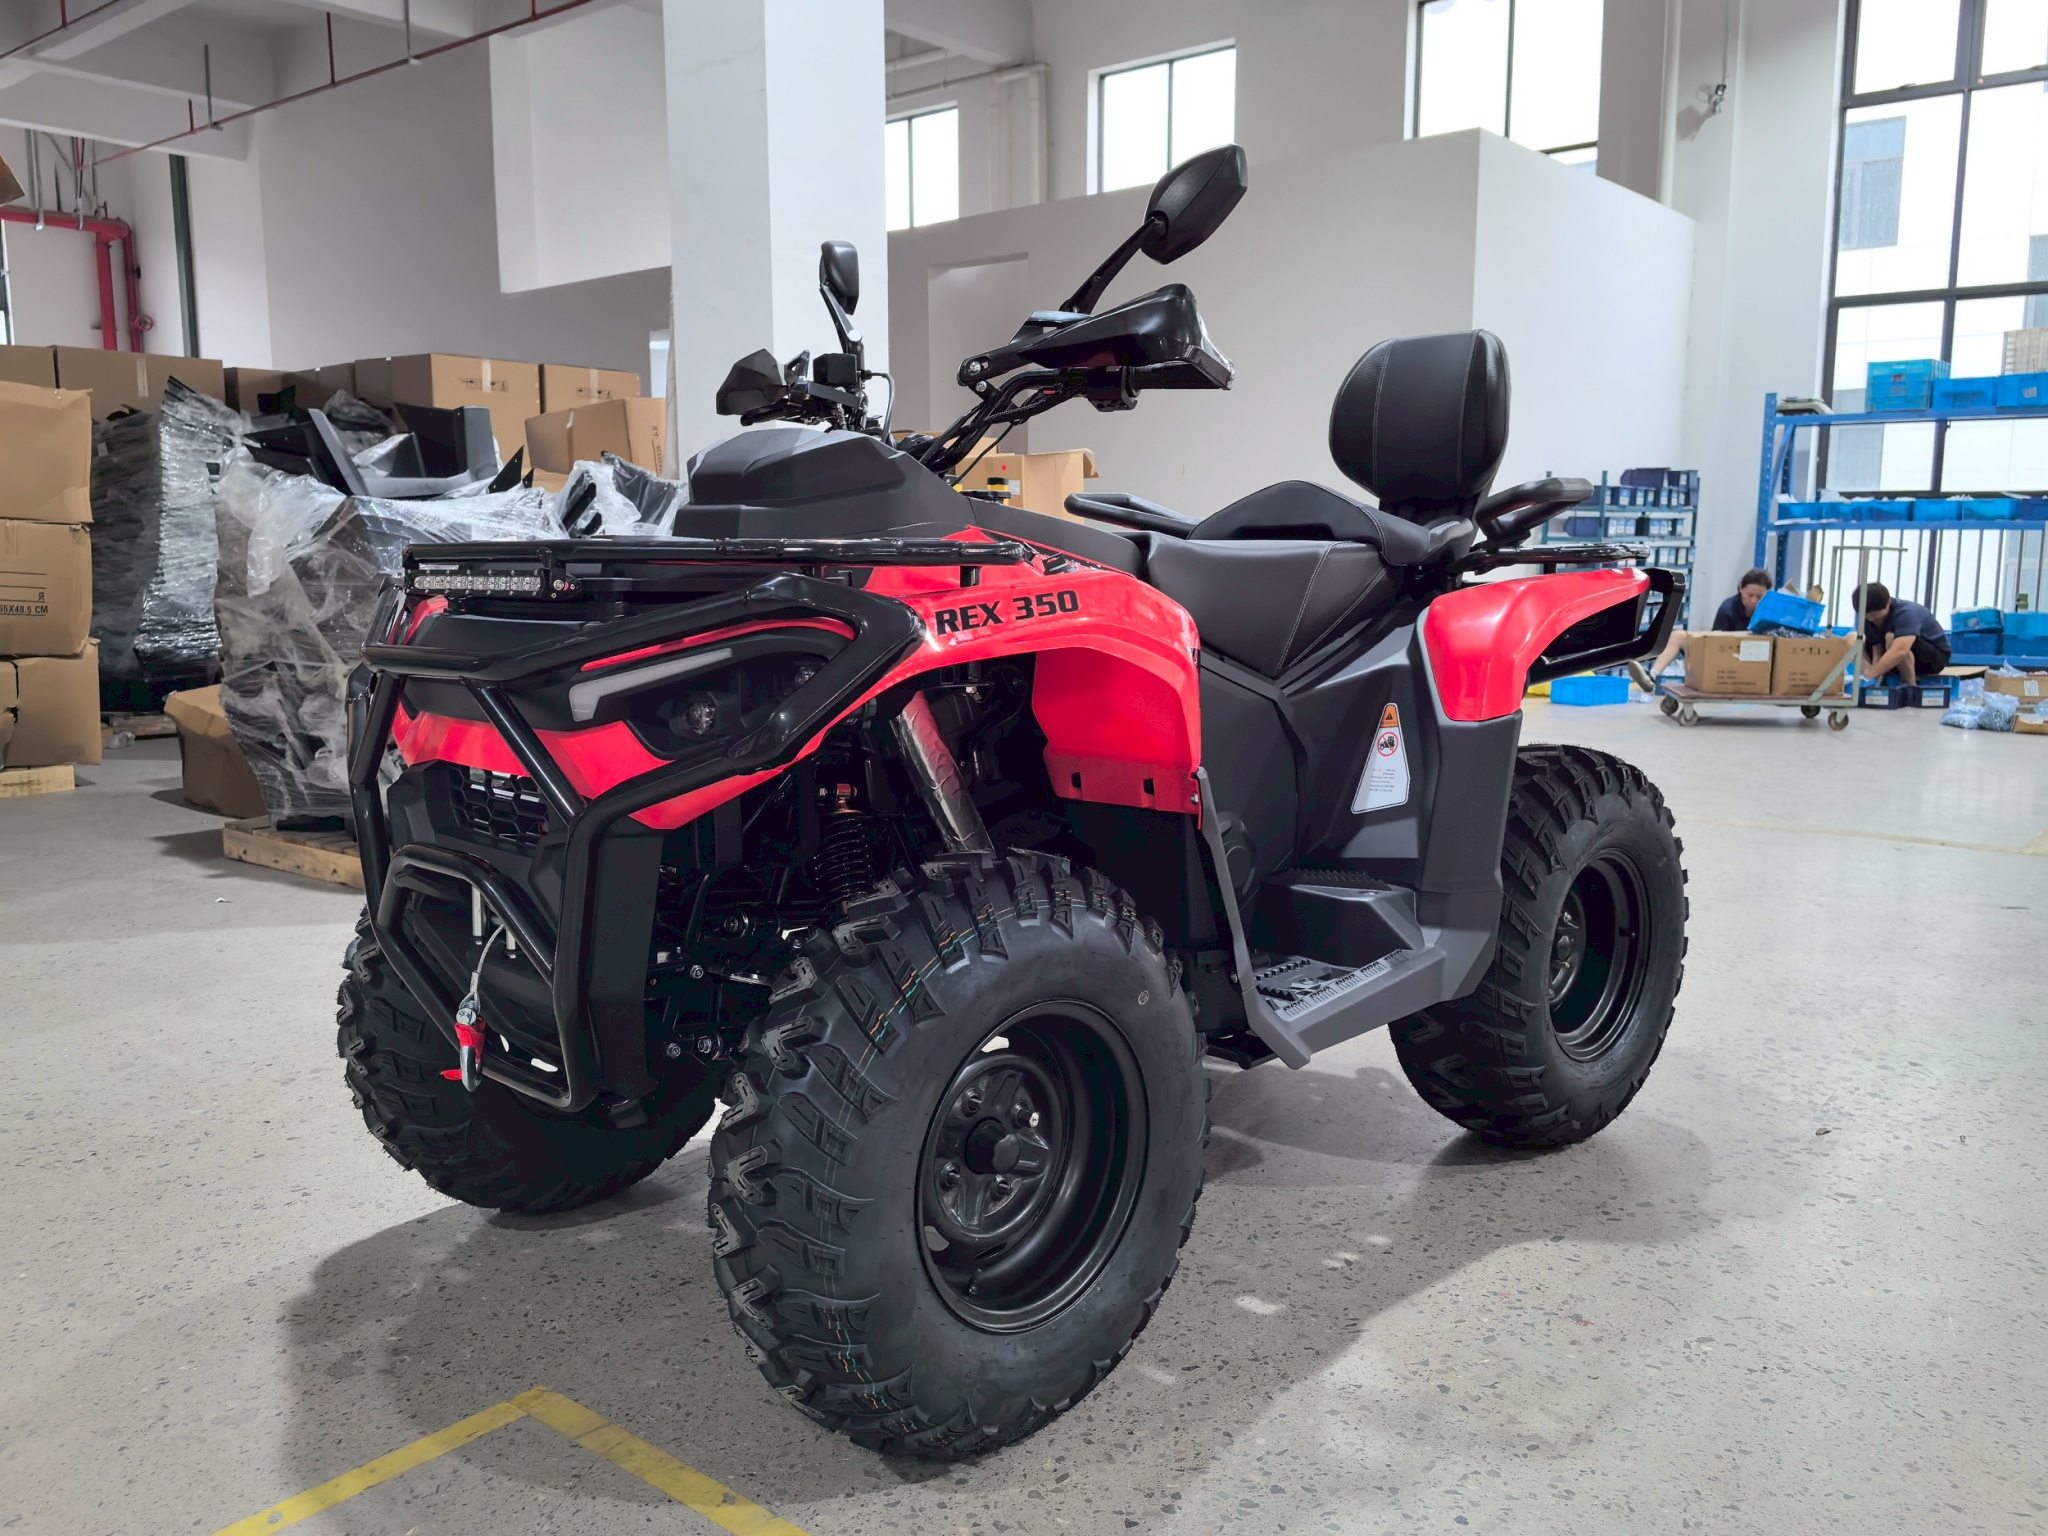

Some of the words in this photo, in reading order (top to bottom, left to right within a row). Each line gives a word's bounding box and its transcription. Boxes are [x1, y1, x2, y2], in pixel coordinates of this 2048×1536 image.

[35, 605, 48, 614] CM
[935, 601, 1004, 635] REX
[1013, 590, 1079, 621] 350
